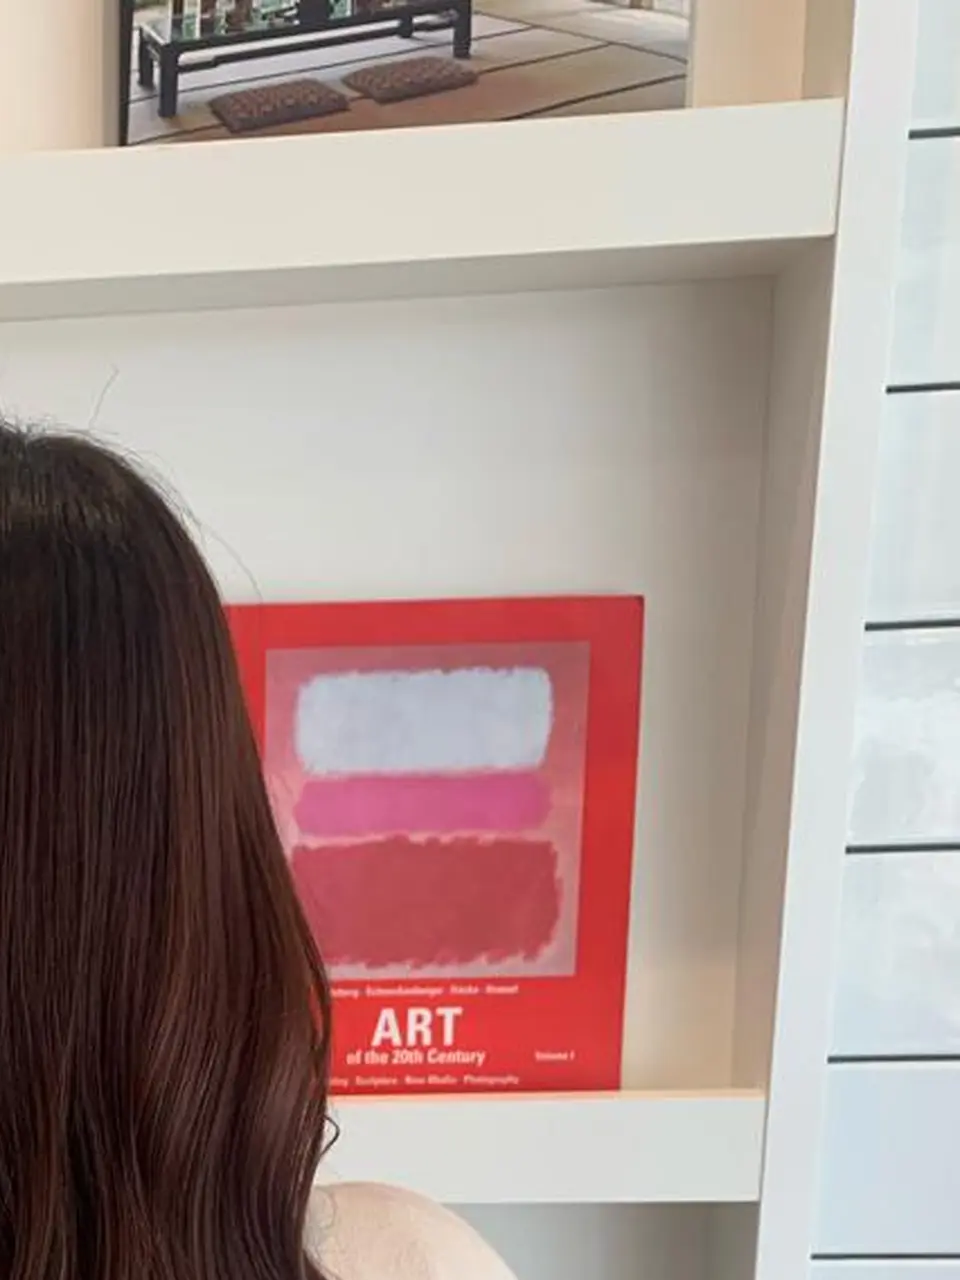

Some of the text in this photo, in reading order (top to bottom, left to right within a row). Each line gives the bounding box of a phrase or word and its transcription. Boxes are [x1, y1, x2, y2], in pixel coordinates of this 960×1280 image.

[371, 1005, 463, 1047] ART
[346, 1047, 486, 1067] of the 20th Century
